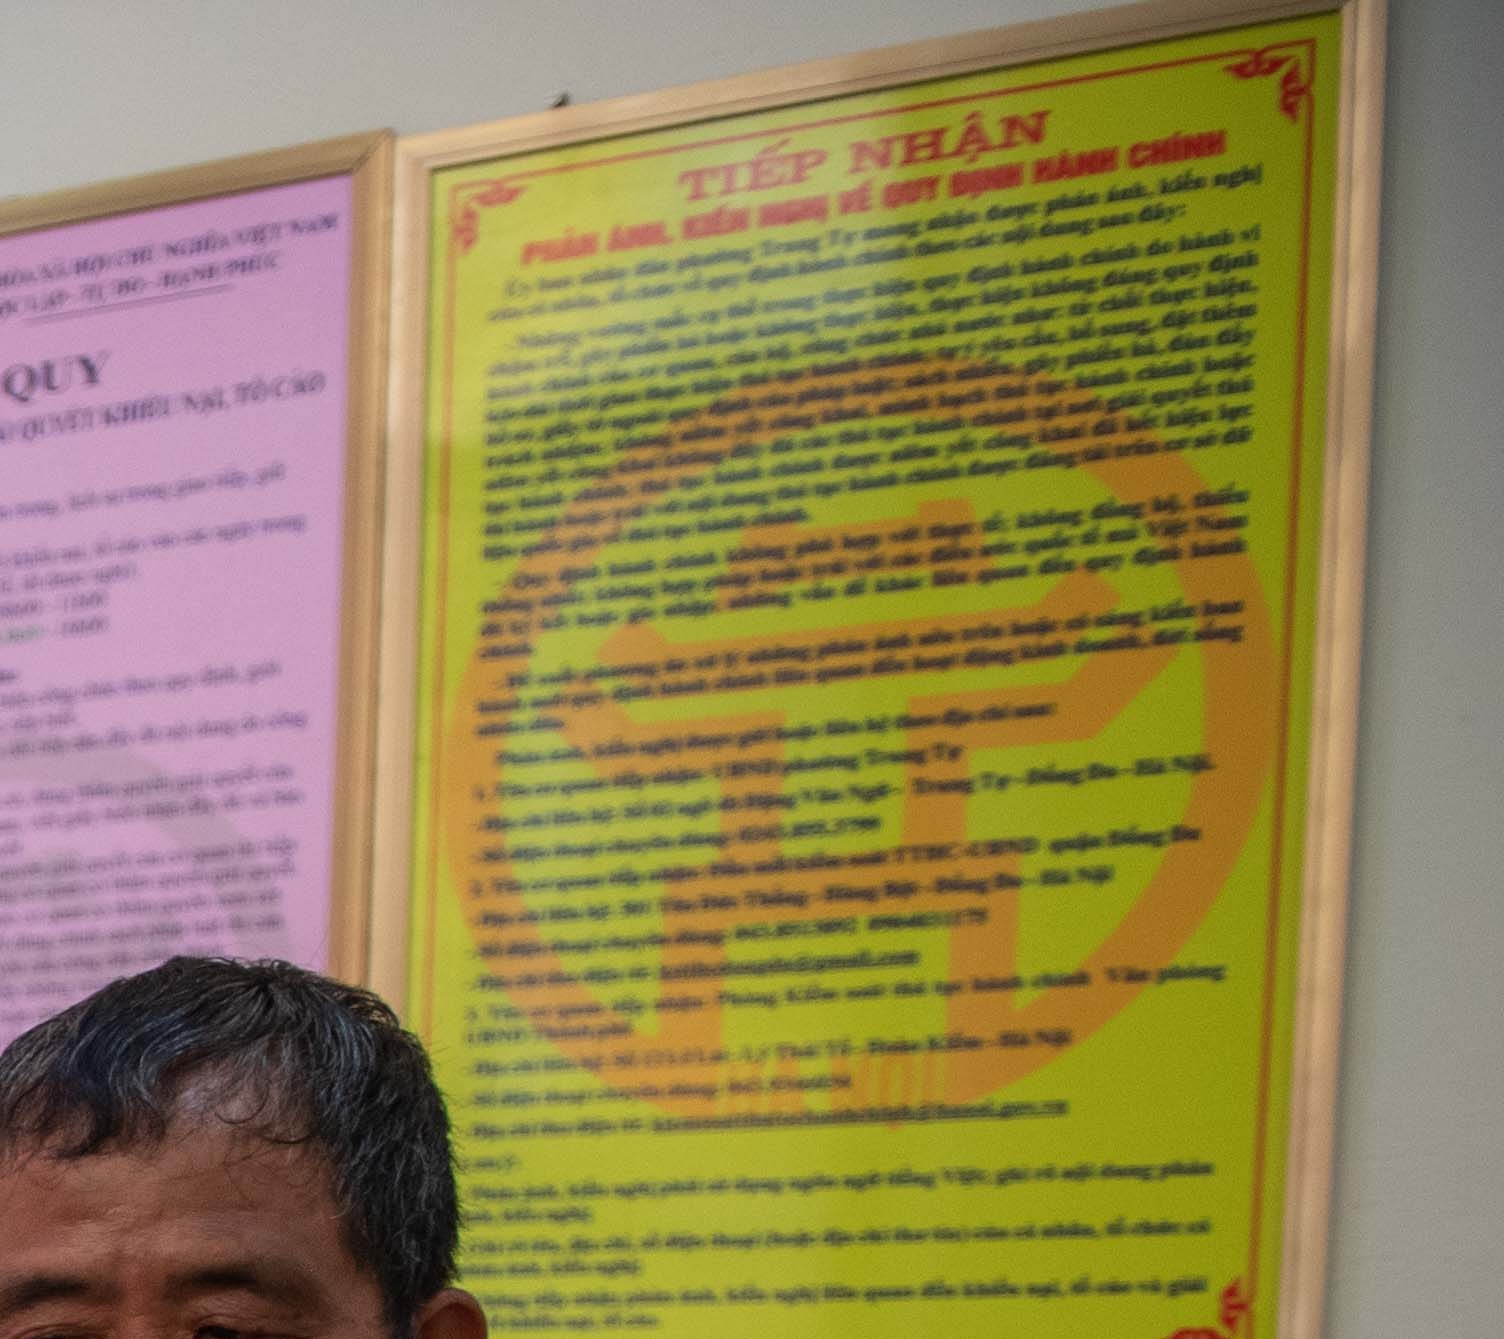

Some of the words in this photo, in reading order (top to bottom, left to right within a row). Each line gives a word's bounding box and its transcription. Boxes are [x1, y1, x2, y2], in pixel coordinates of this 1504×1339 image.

[678, 139, 827, 201] TIẾP
[849, 110, 1048, 173] NHẬN
[838, 180, 872, 215] VỀ
[882, 174, 940, 209] QUY
[1033, 147, 1119, 184] HÀNH
[1126, 130, 1227, 169] CHÍNH
[0, 354, 110, 404] QUY
